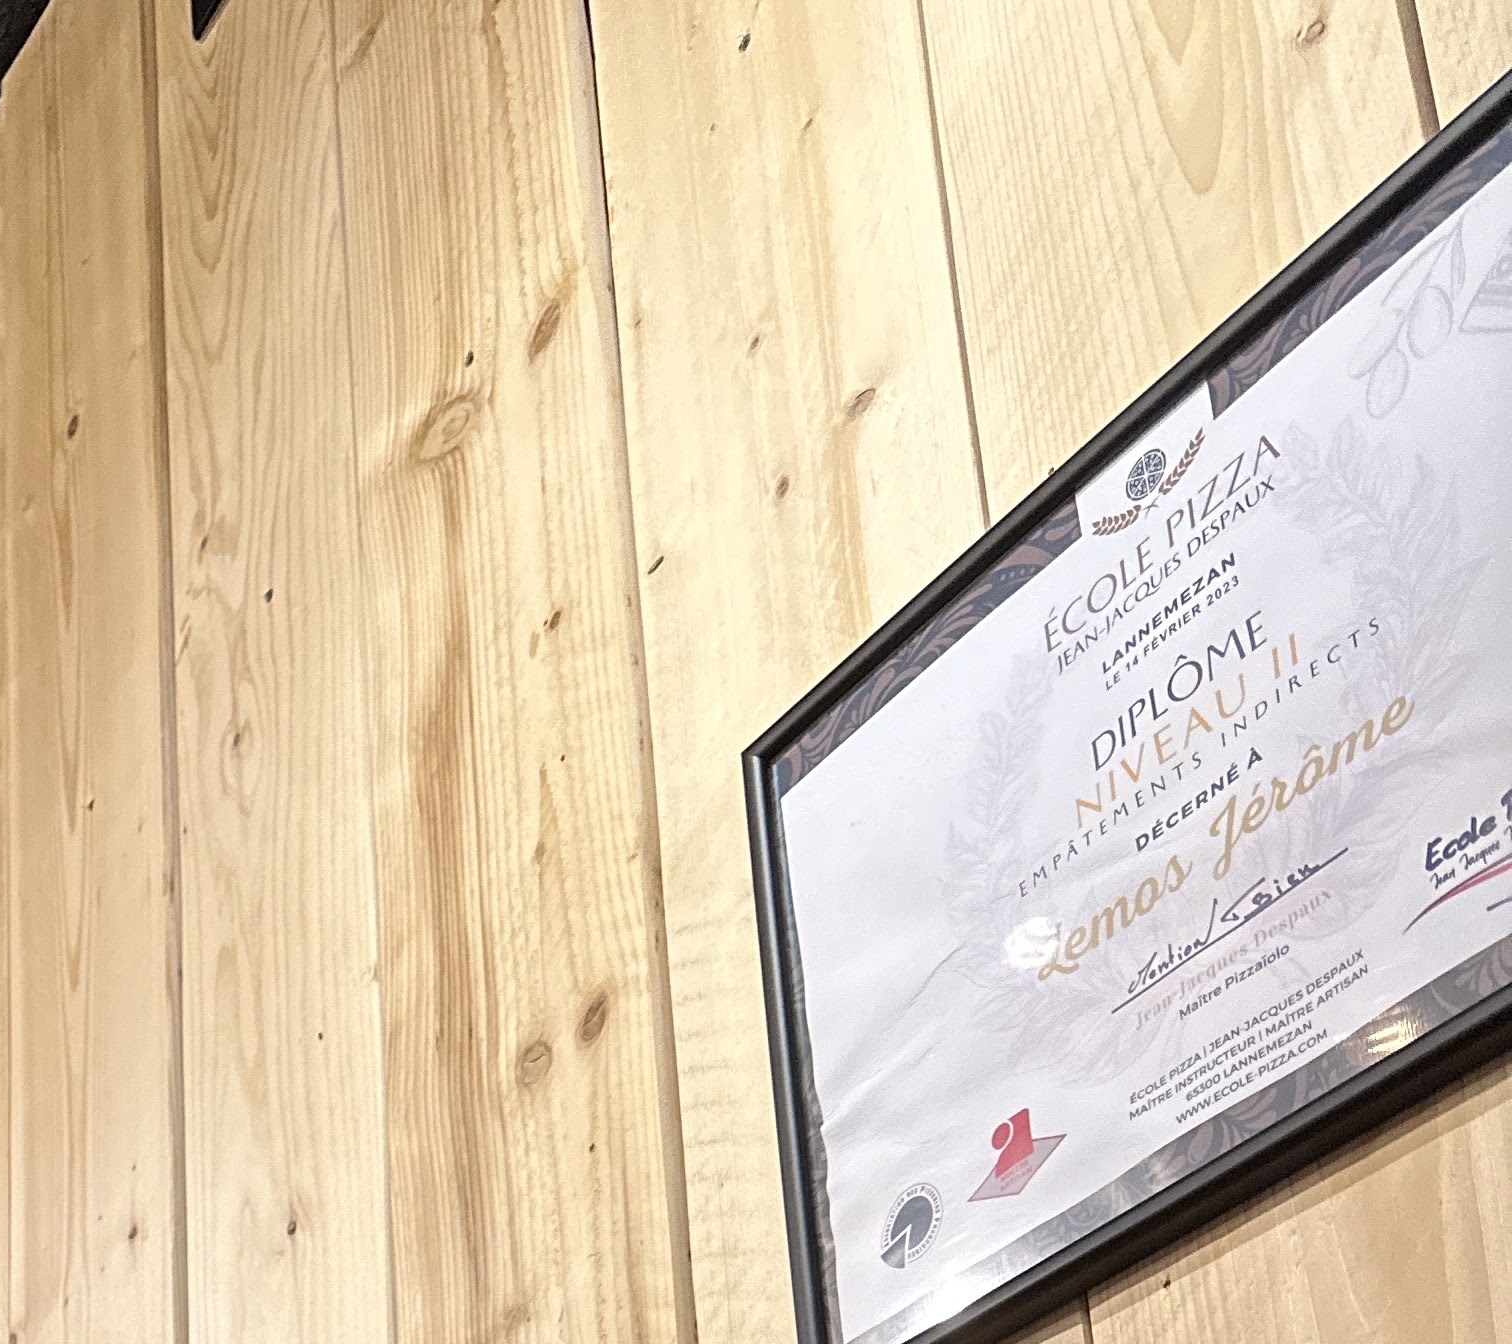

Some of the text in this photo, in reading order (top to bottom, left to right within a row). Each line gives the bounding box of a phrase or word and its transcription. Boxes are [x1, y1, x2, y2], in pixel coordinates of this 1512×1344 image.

[1044, 435, 1281, 653] ÉCOLE PIZZA
[1057, 474, 1275, 675] JEAN-JACQUES DESPAUX
[1102, 553, 1236, 674] LANNEMEZAN
[1105, 575, 1240, 691] LE 14 FÉVRIER 2023
[1075, 632, 1299, 829] NIVEAU II
[1091, 610, 1267, 772] DIPLÔME
[1018, 617, 1380, 898] EMPÂTEMENTS INDIRECTS
[1135, 763, 1240, 852] DÉCERNÉ
[1037, 695, 1416, 981] Lemos Jérôme
[1425, 816, 1497, 872] Ecole
[1168, 1052, 1202, 1081] PIZZA
[1208, 990, 1304, 1053] JEAN-JACQUES
[1306, 948, 1365, 996] DESPAUX
[1175, 1037, 1256, 1094] INSTRUCTEUR
[1316, 964, 1369, 1007] ARTISAN
[1175, 1028, 1328, 1125] WWW.ECOLE-PIZZA.COM
[1223, 1020, 1312, 1078] LANNEMEZAN
